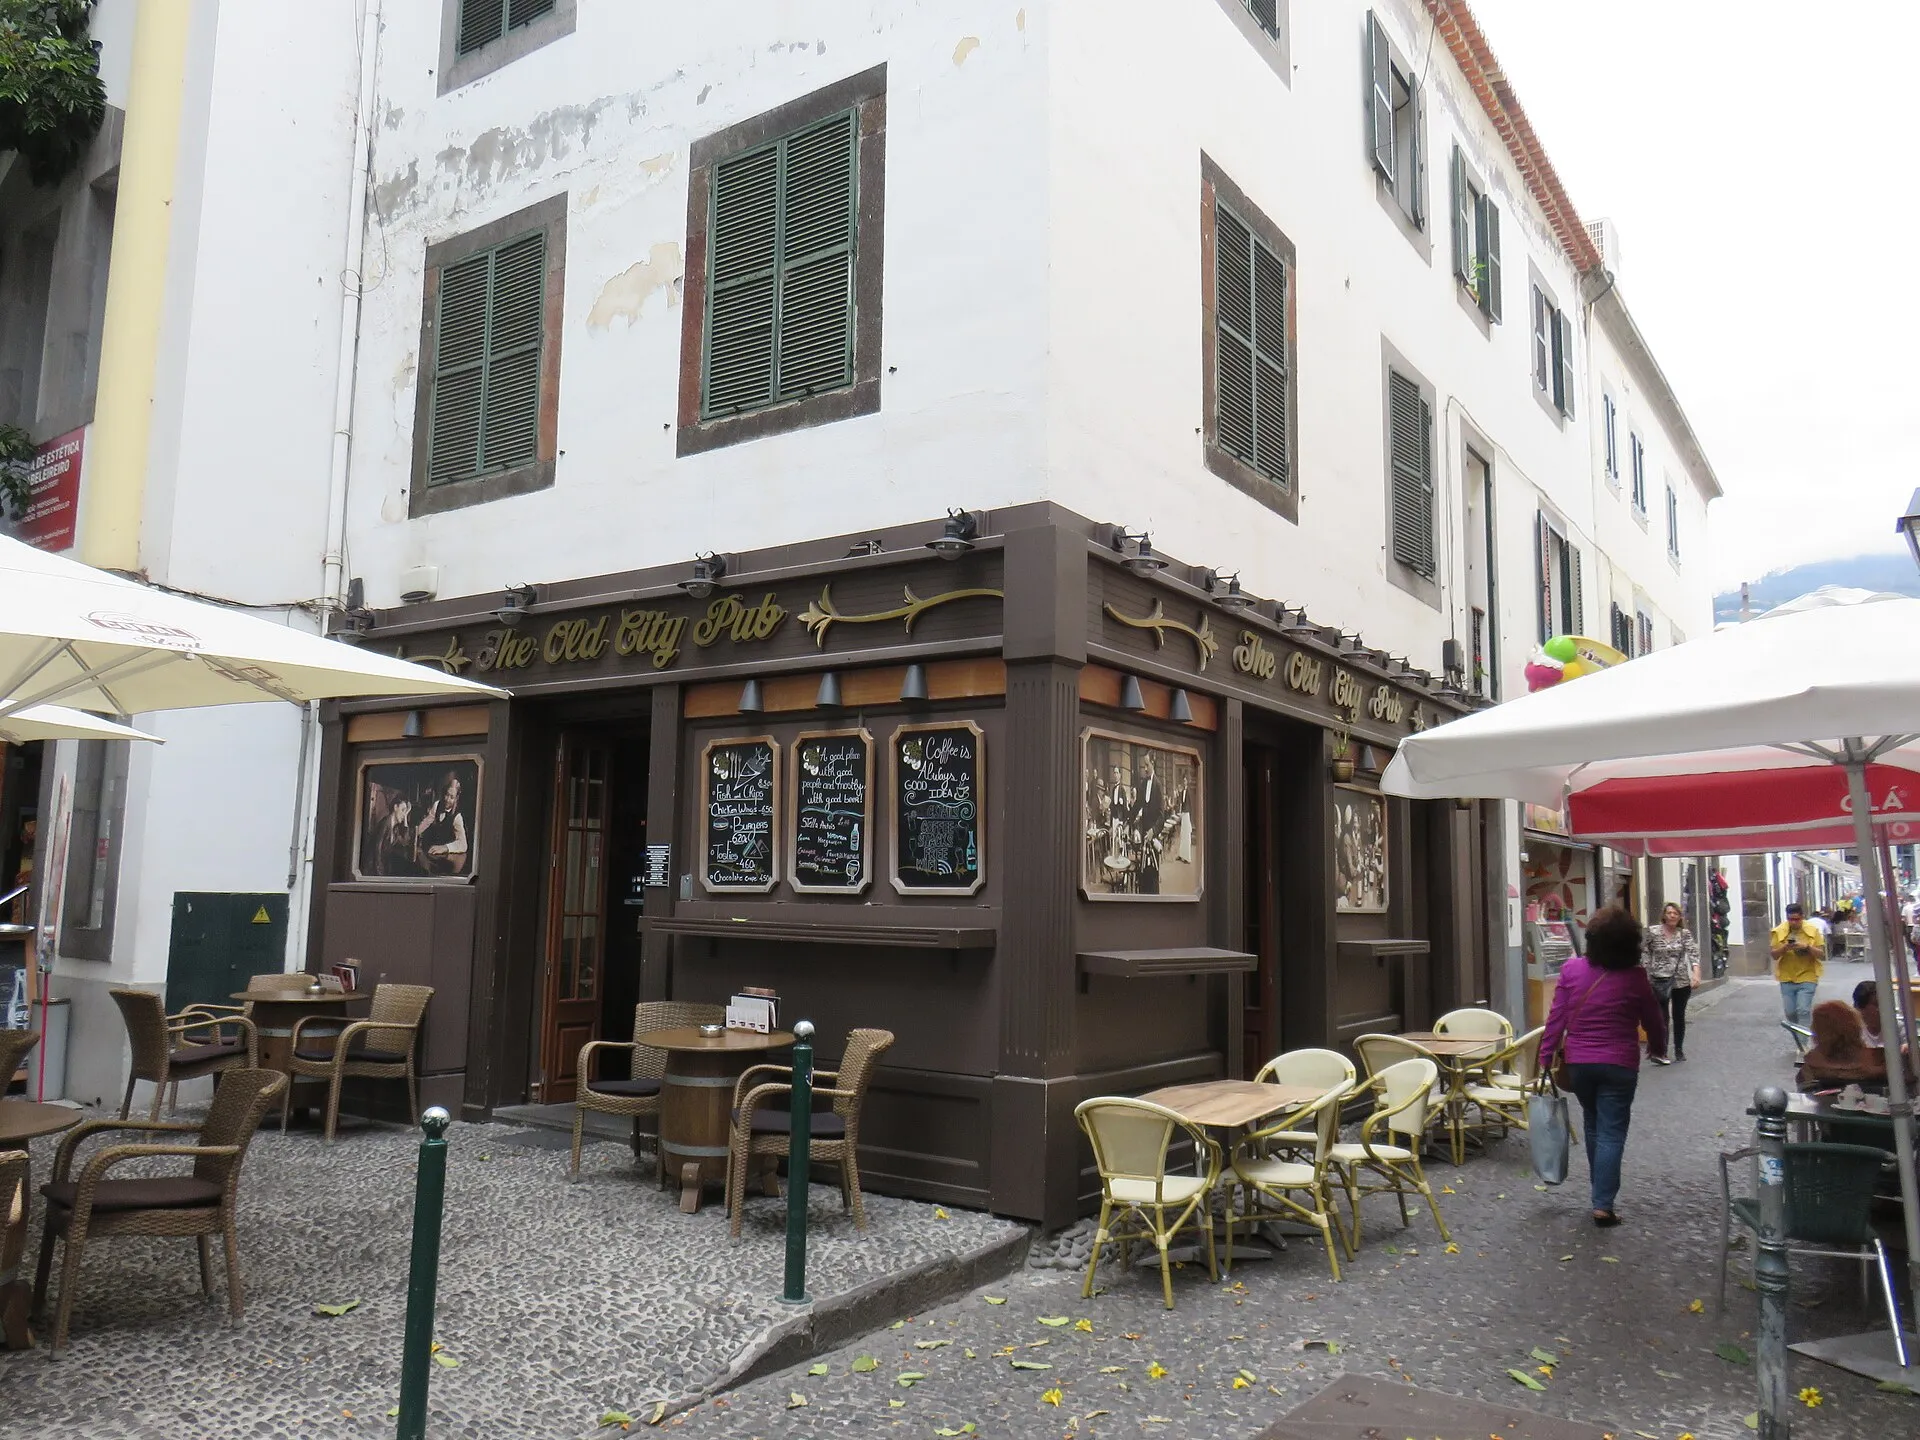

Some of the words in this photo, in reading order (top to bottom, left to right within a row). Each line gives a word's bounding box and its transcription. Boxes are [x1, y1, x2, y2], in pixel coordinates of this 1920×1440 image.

[36, 454, 45, 468] DE
[46, 440, 80, 465] ESTÉTICA
[477, 629, 538, 672] The
[544, 615, 610, 664] Old
[615, 607, 687, 669] City
[693, 592, 788, 647] Pub
[1233, 629, 1276, 680] The
[1284, 651, 1322, 696] Old
[1329, 665, 1363, 724] City
[1368, 684, 1404, 724] Pub
[820, 747, 828, 762] A
[828, 746, 844, 771] good
[845, 747, 860, 766] place
[926, 736, 958, 764] Coffee
[960, 745, 972, 759] is
[802, 777, 821, 795] people
[823, 780, 835, 790] and
[835, 764, 853, 785] good
[904, 779, 928, 791] GOOD
[918, 760, 958, 791] Always
[961, 772, 970, 781] a
[825, 793, 842, 812] good
[929, 788, 953, 799] IDEA
[923, 847, 949, 861] FREE
